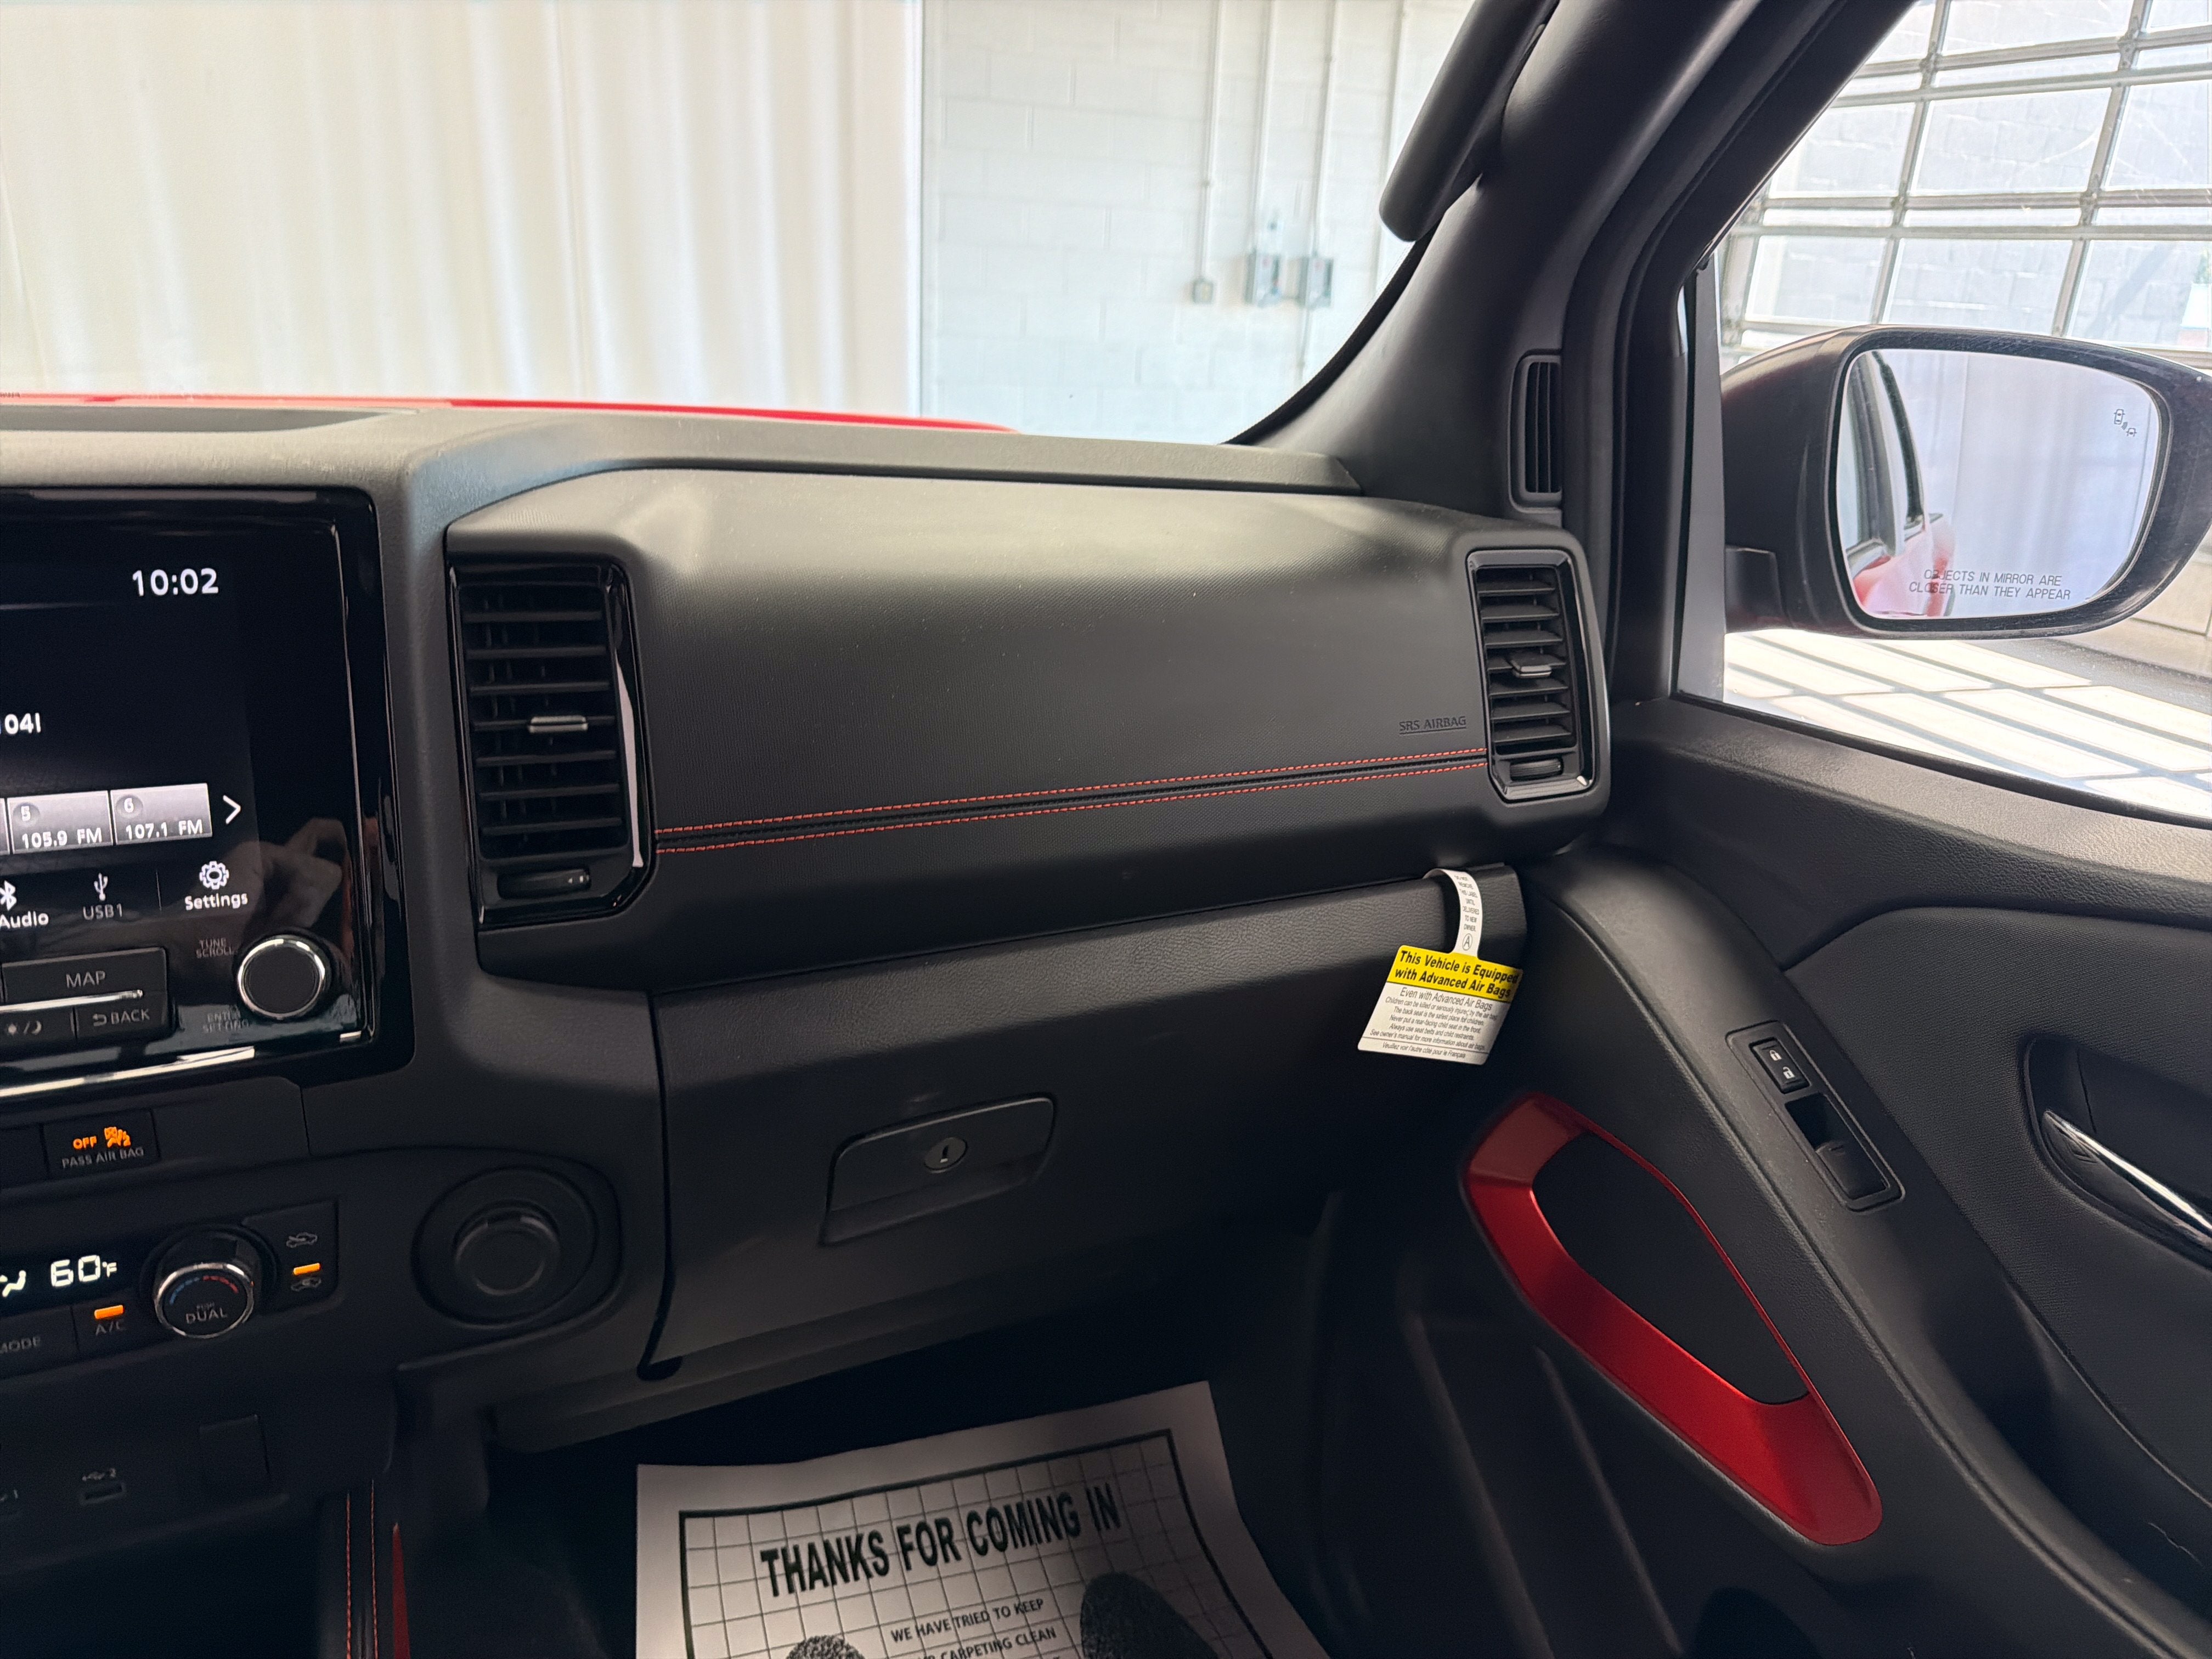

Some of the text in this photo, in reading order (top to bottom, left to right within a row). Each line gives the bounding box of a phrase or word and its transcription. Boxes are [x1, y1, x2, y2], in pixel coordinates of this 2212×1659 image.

[133, 568, 219, 596] 10:02
[1924, 569, 2062, 586] OBJECTS IN MIRROR ARE
[1909, 582, 2071, 600] CLOSER THAN THEY APPEAR
[1400, 715, 1467, 731] SRS AIRBAG
[20, 805, 31, 821] 5
[123, 797, 134, 814] 6
[22, 827, 103, 849] 105.9 FM
[126, 819, 203, 840] 107.1 FM
[184, 892, 249, 912] Settings
[0, 910, 49, 929] Audio
[199, 938, 227, 950] TUNE
[1400, 950, 1519, 984] This Vehicle is Equipped
[65, 970, 106, 989] MAP
[1395, 968, 1511, 998] with Advanced Air Bags
[1400, 987, 1493, 1012] Even with Advanced Air Bags
[111, 1008, 150, 1025] BACK
[72, 1136, 98, 1150] OFF
[62, 1147, 145, 1169] PASS AIR BAG
[185, 1307, 228, 1324] DUAL
[95, 1319, 125, 1336] A/C
[760, 1482, 1122, 1598] THANKS FOR COMING IN
[890, 1598, 1045, 1643] WE HAVE TRIED TO KEEP
[940, 1627, 1057, 1659] CARPETING CLEAN
